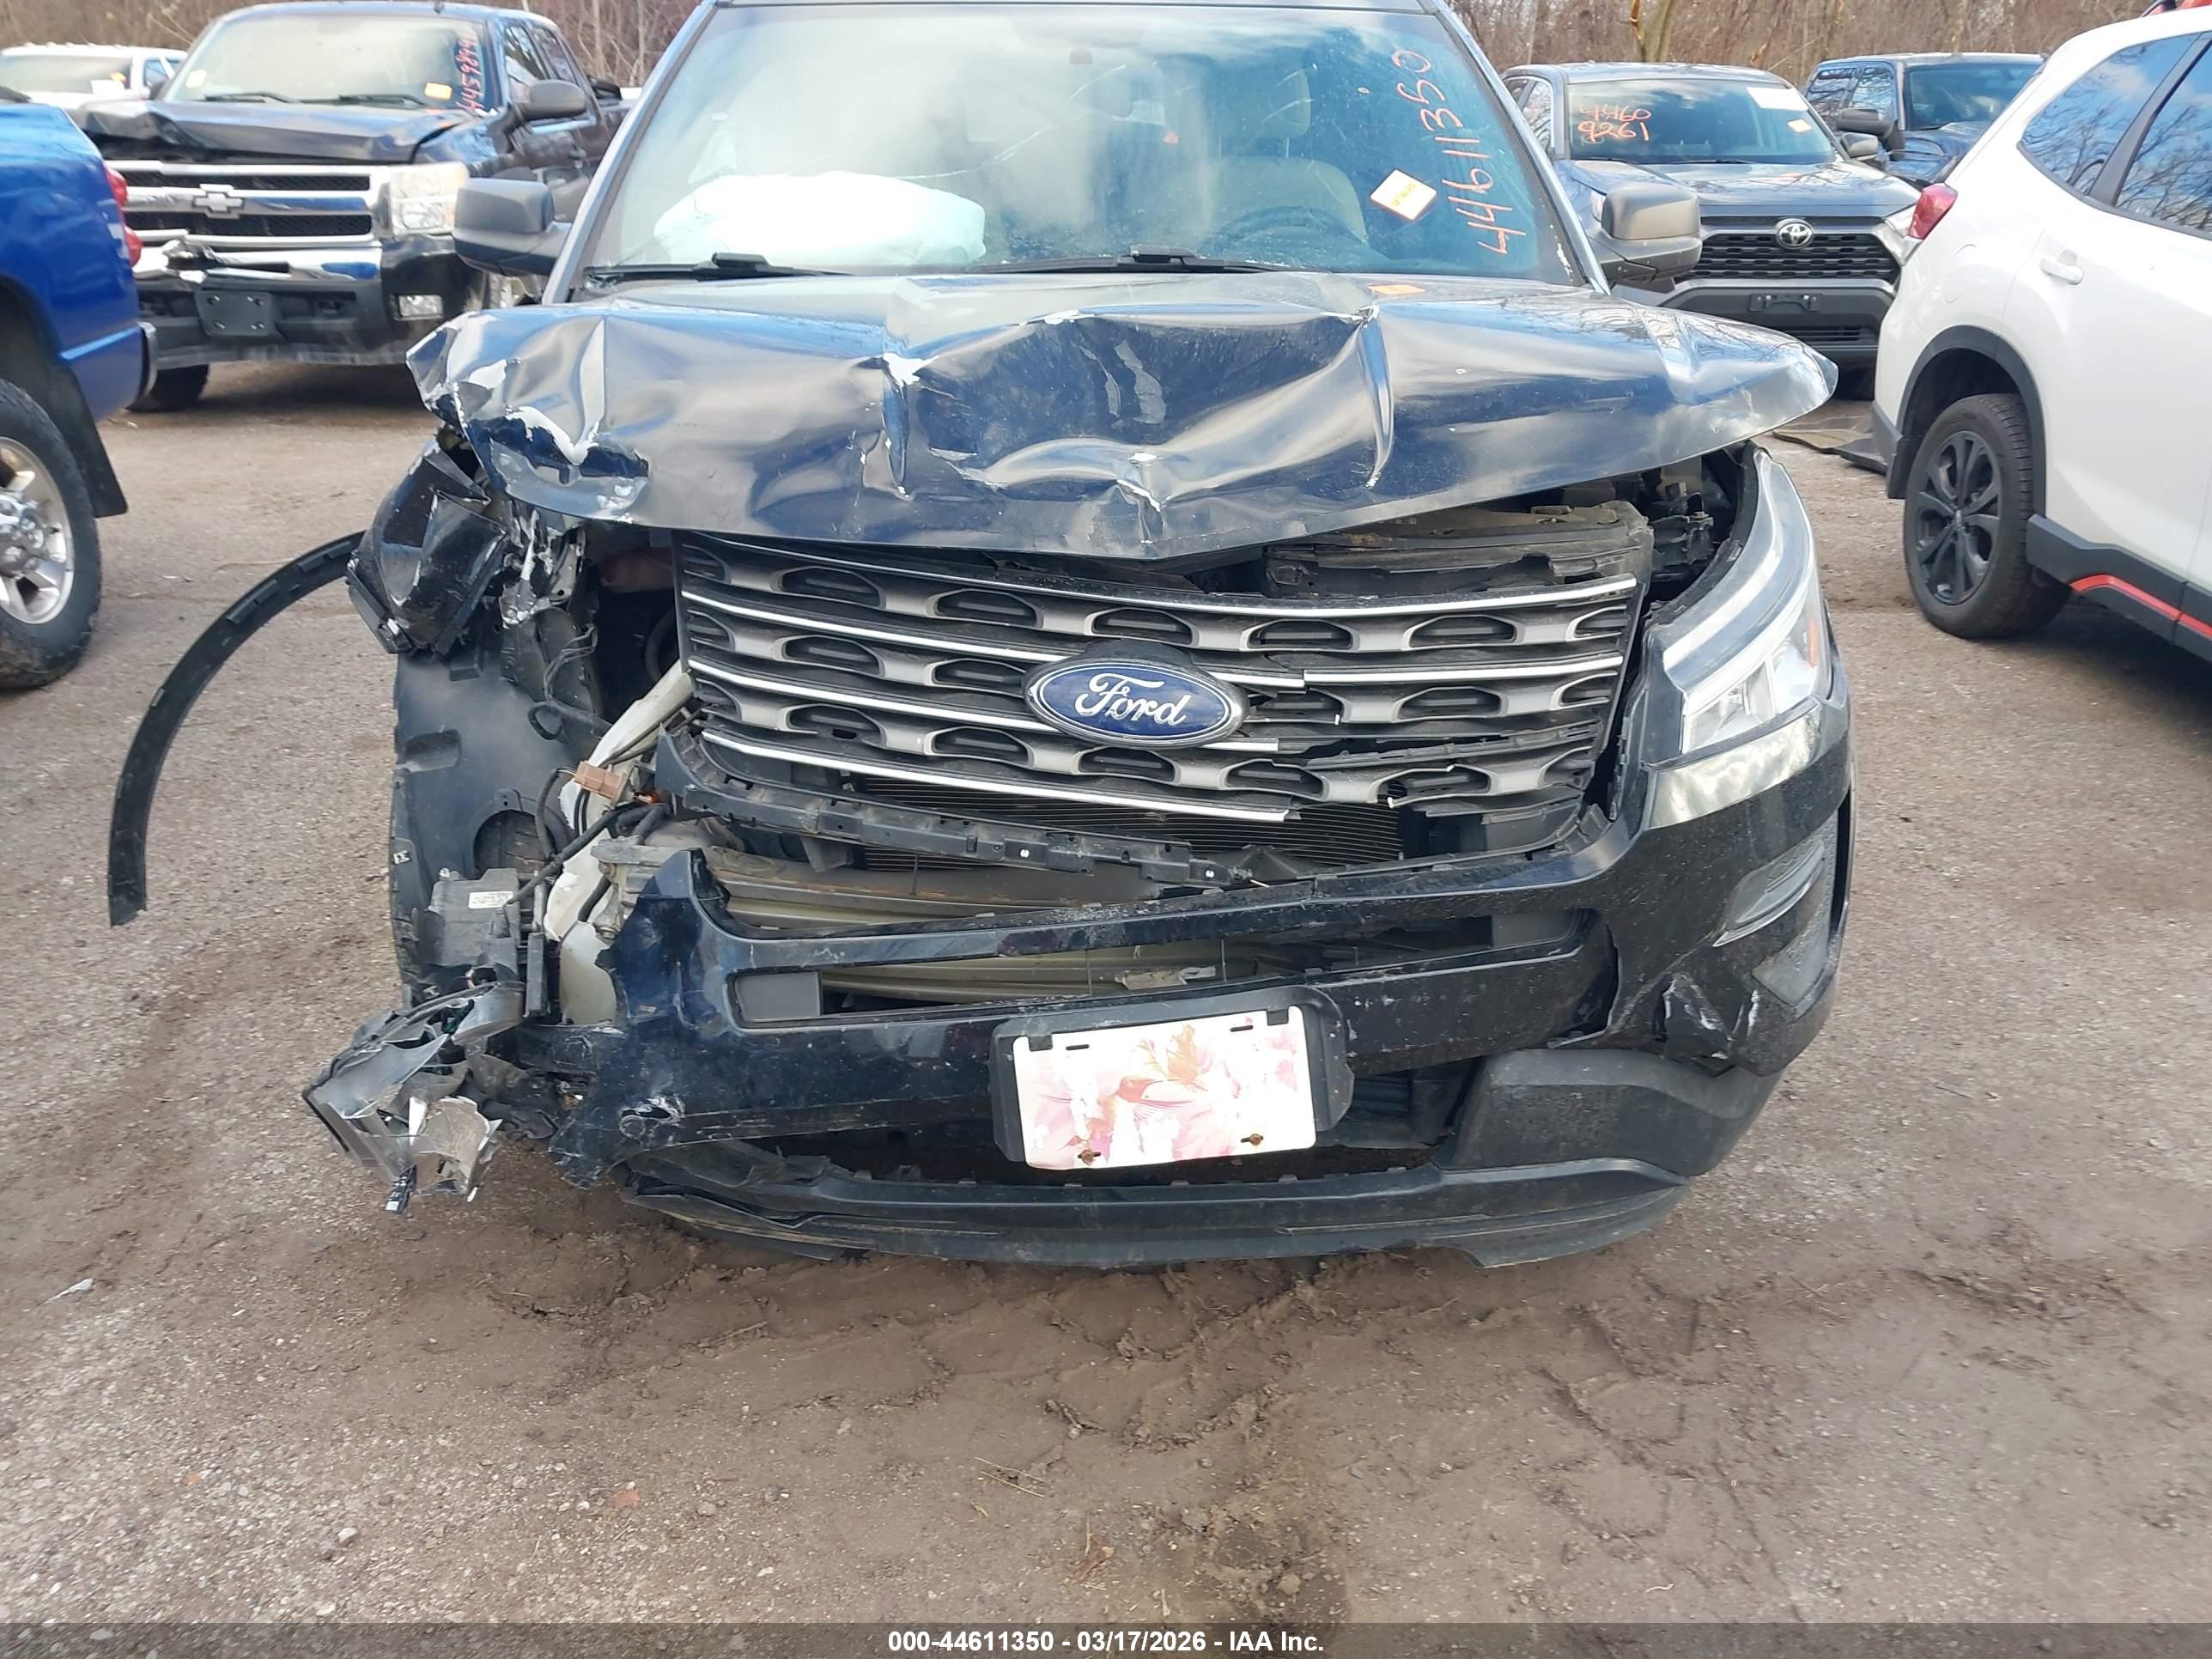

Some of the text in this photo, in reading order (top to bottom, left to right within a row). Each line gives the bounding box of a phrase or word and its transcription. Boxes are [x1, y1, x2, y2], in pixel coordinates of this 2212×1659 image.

[1391, 50, 1526, 254] 44611350
[1577, 121, 1650, 142] 9261
[1075, 673, 1192, 726] Ford
